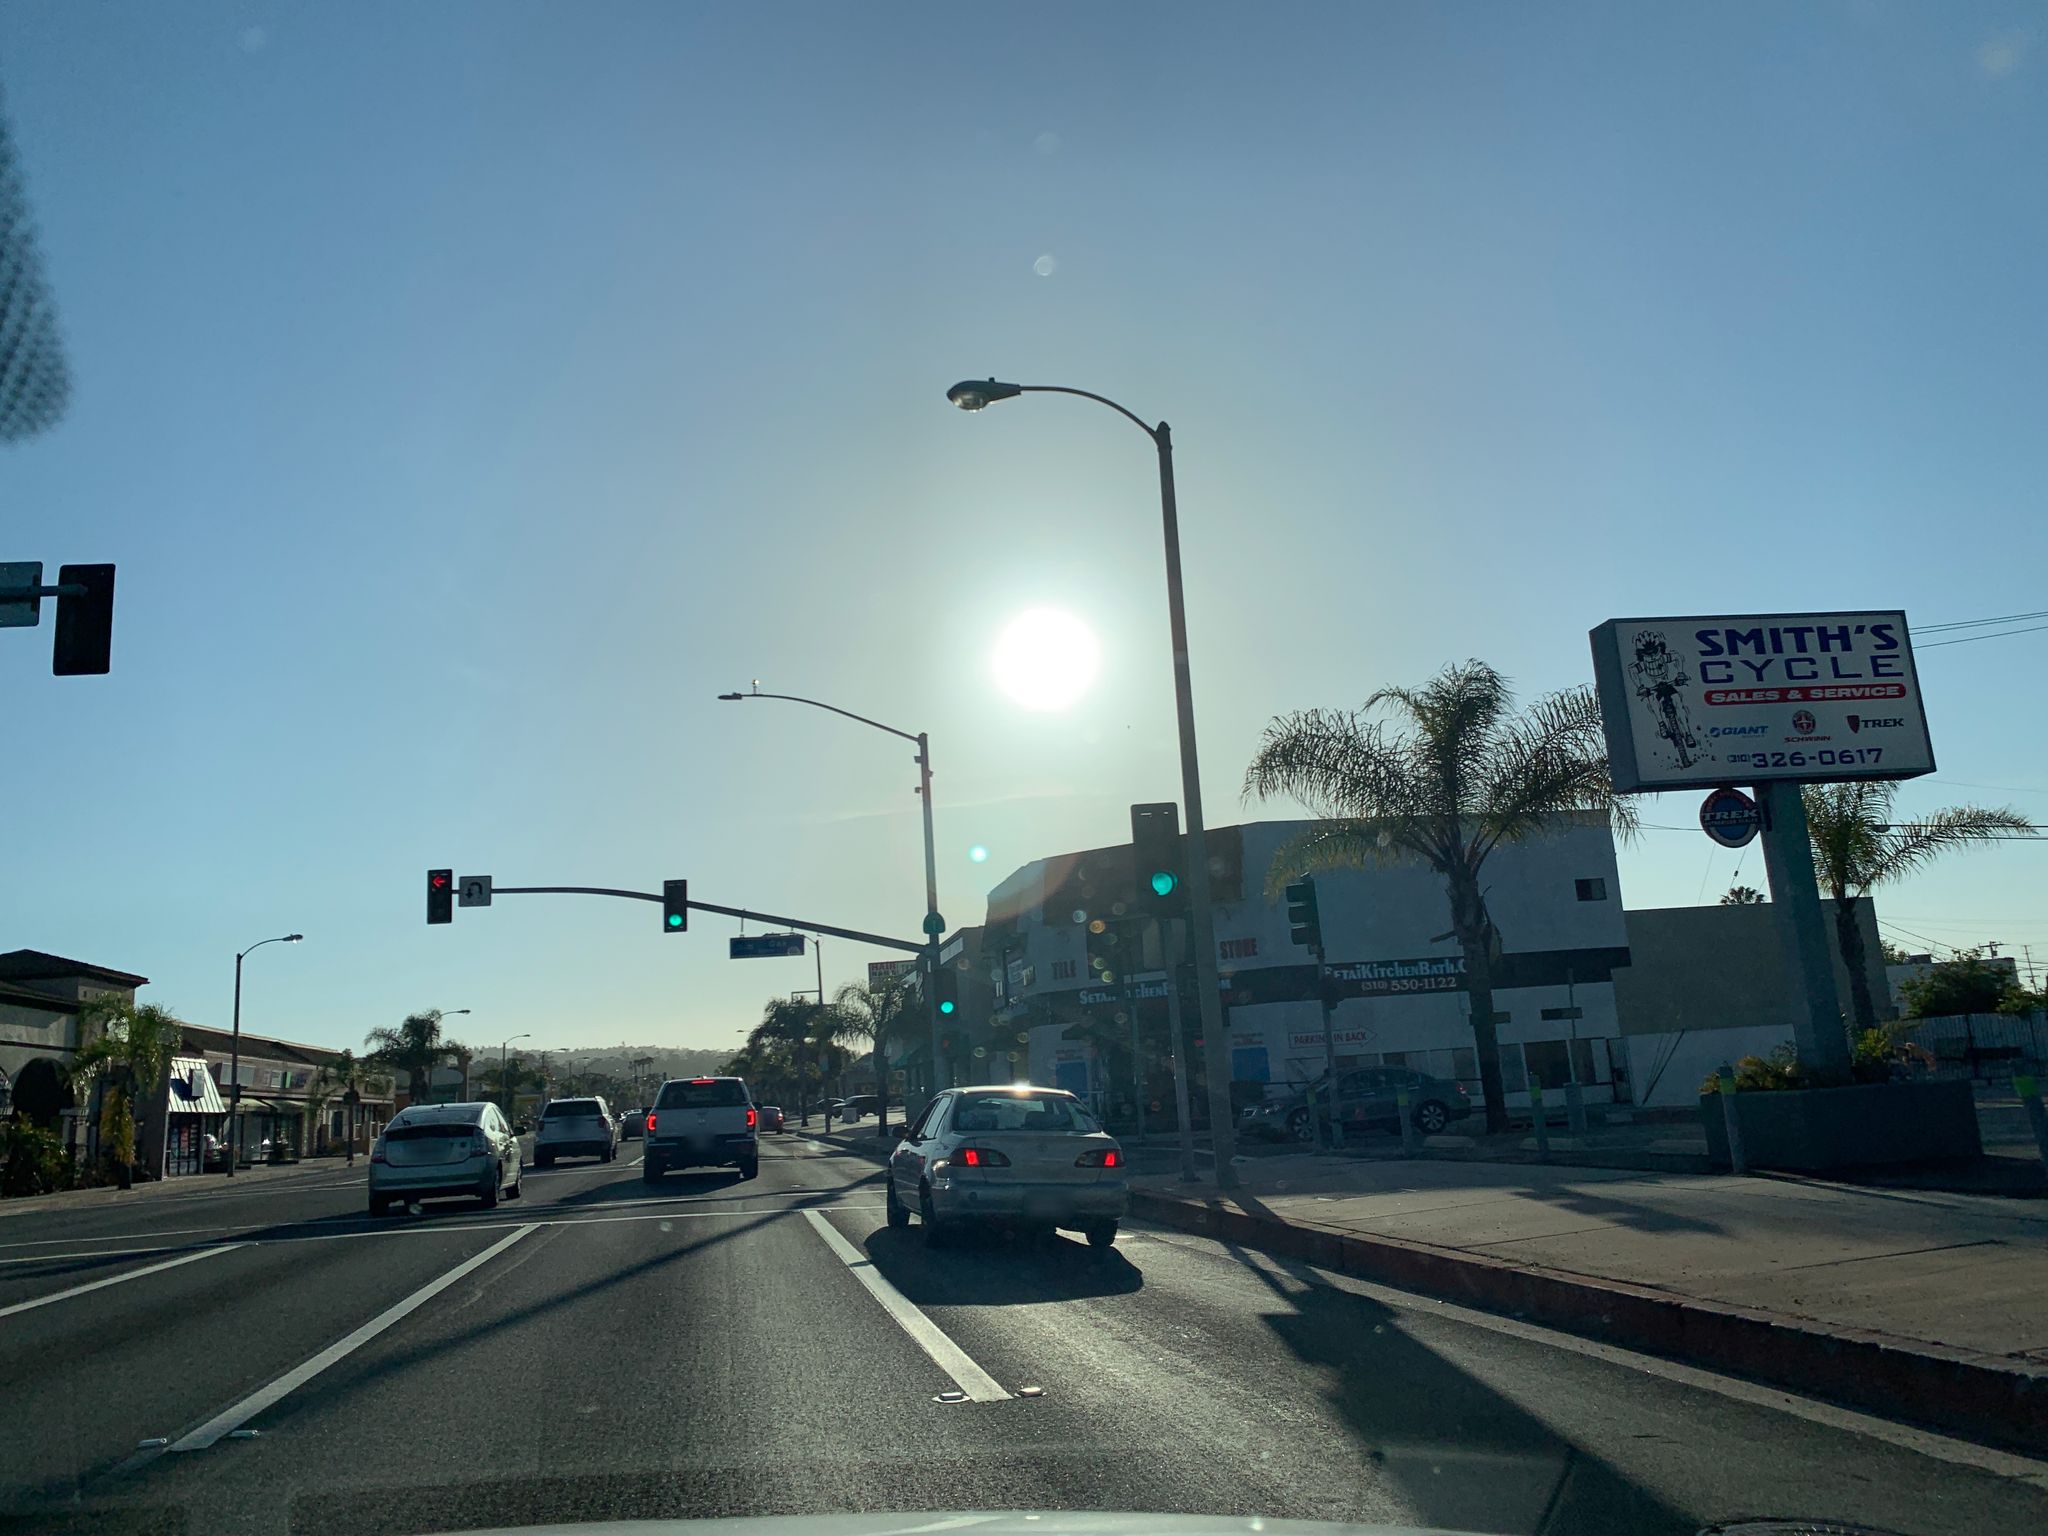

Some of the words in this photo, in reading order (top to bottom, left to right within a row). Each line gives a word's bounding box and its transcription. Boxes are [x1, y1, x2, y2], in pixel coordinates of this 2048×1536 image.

[1695, 624, 1899, 656] SMITH'S
[1699, 654, 1904, 684] CYCLE
[1711, 690, 1780, 702] SALES
[1787, 690, 1803, 700] &
[1811, 686, 1900, 699] SERVICE
[1860, 718, 1905, 729] TREK
[1723, 726, 1768, 736] GIANT
[1784, 735, 1831, 743] SCHWINN
[1752, 748, 1883, 768] 326-0617
[1703, 809, 1759, 821] TREK
[1219, 937, 1258, 960] STORE
[871, 963, 896, 971] HAIR
[1333, 1033, 1343, 1043] IN
[1345, 1031, 1367, 1042] BACK
